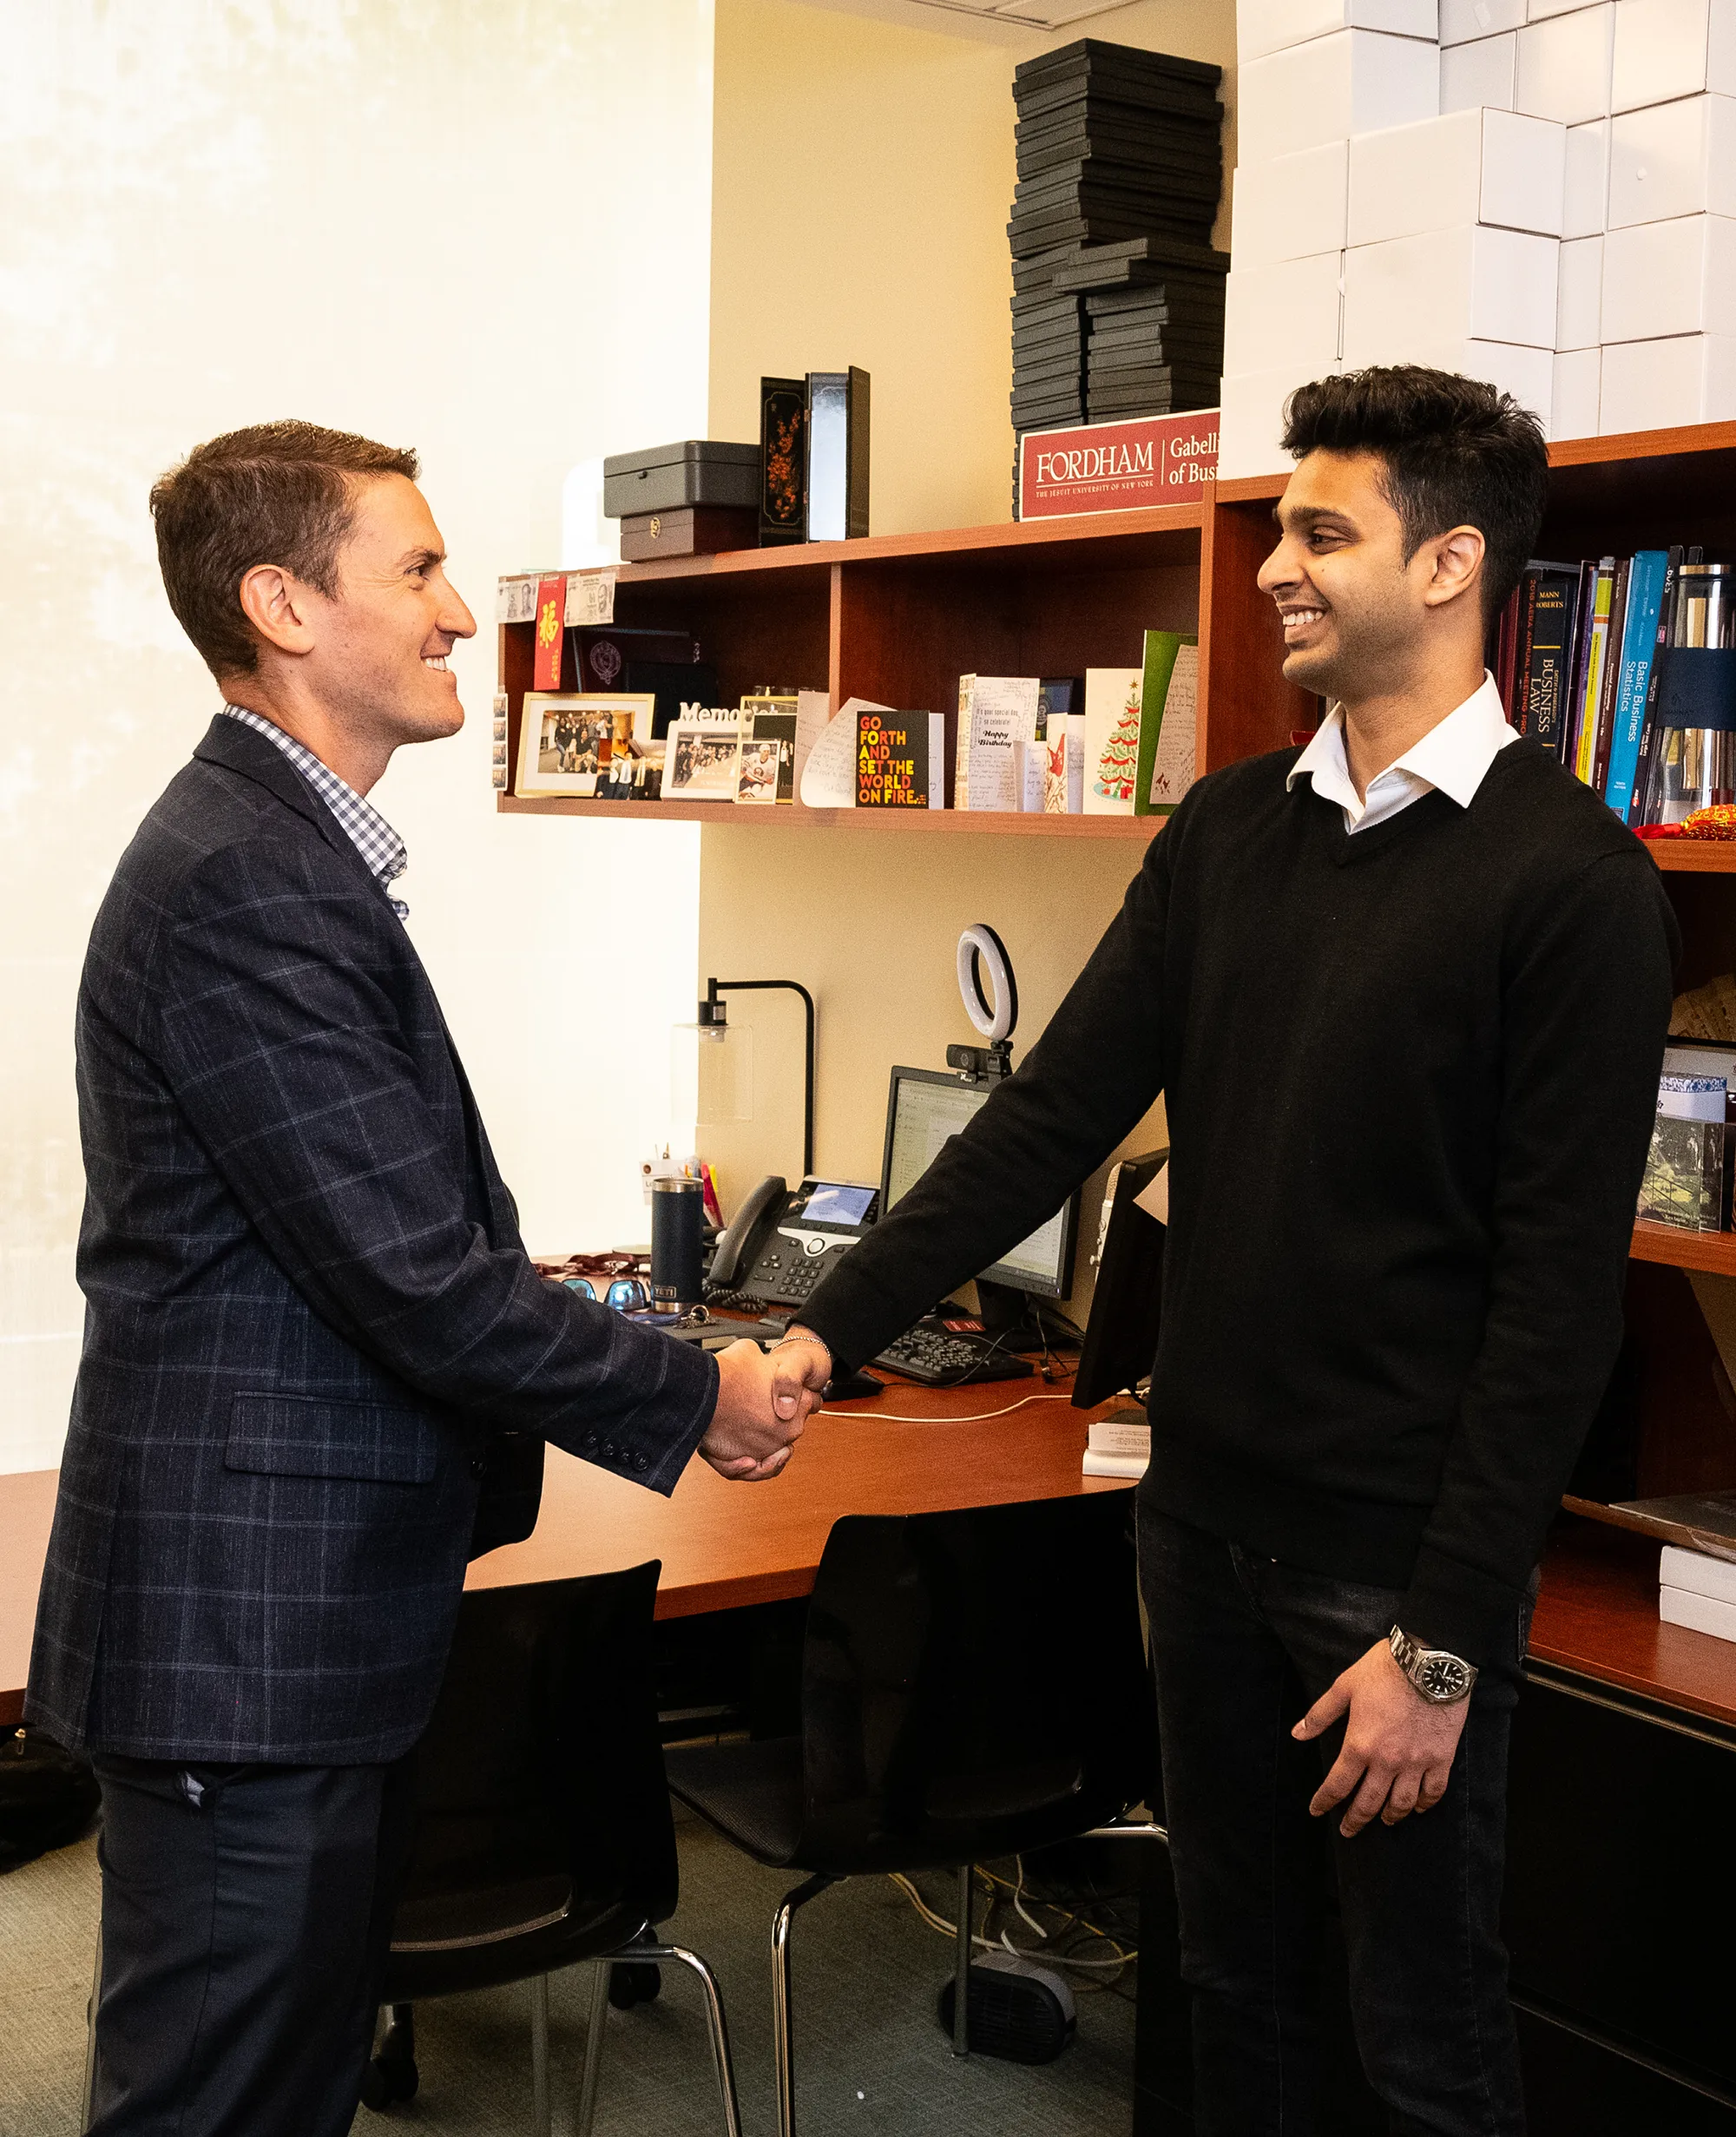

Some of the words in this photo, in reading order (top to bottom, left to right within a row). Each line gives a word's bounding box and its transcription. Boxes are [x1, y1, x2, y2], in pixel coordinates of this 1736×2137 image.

[1036, 442, 1154, 483] FORDHAM
[1169, 463, 1187, 484] of
[1050, 488, 1070, 497] JESUIT
[1073, 484, 1109, 495] UNIVERSITY
[1121, 481, 1135, 490] NEW
[1524, 629, 1533, 668] ANNUAL
[1635, 661, 1647, 691] Basic
[1521, 672, 1530, 712] MEETING
[1621, 661, 1635, 712] Statistics
[1529, 678, 1542, 713] LAW
[1538, 659, 1555, 733] BUSINESS
[995, 708, 1009, 717] special
[1628, 695, 1643, 741] Business
[860, 716, 882, 730] GO
[860, 731, 906, 745] FORTH
[978, 740, 1012, 748] Birthday
[859, 745, 891, 759] AND
[859, 760, 884, 774] SET
[887, 760, 914, 774] THE
[859, 774, 911, 790] WORLD
[859, 790, 880, 804] ON
[884, 790, 917, 804] FIRE.
[654, 1287, 674, 1297] YETI
